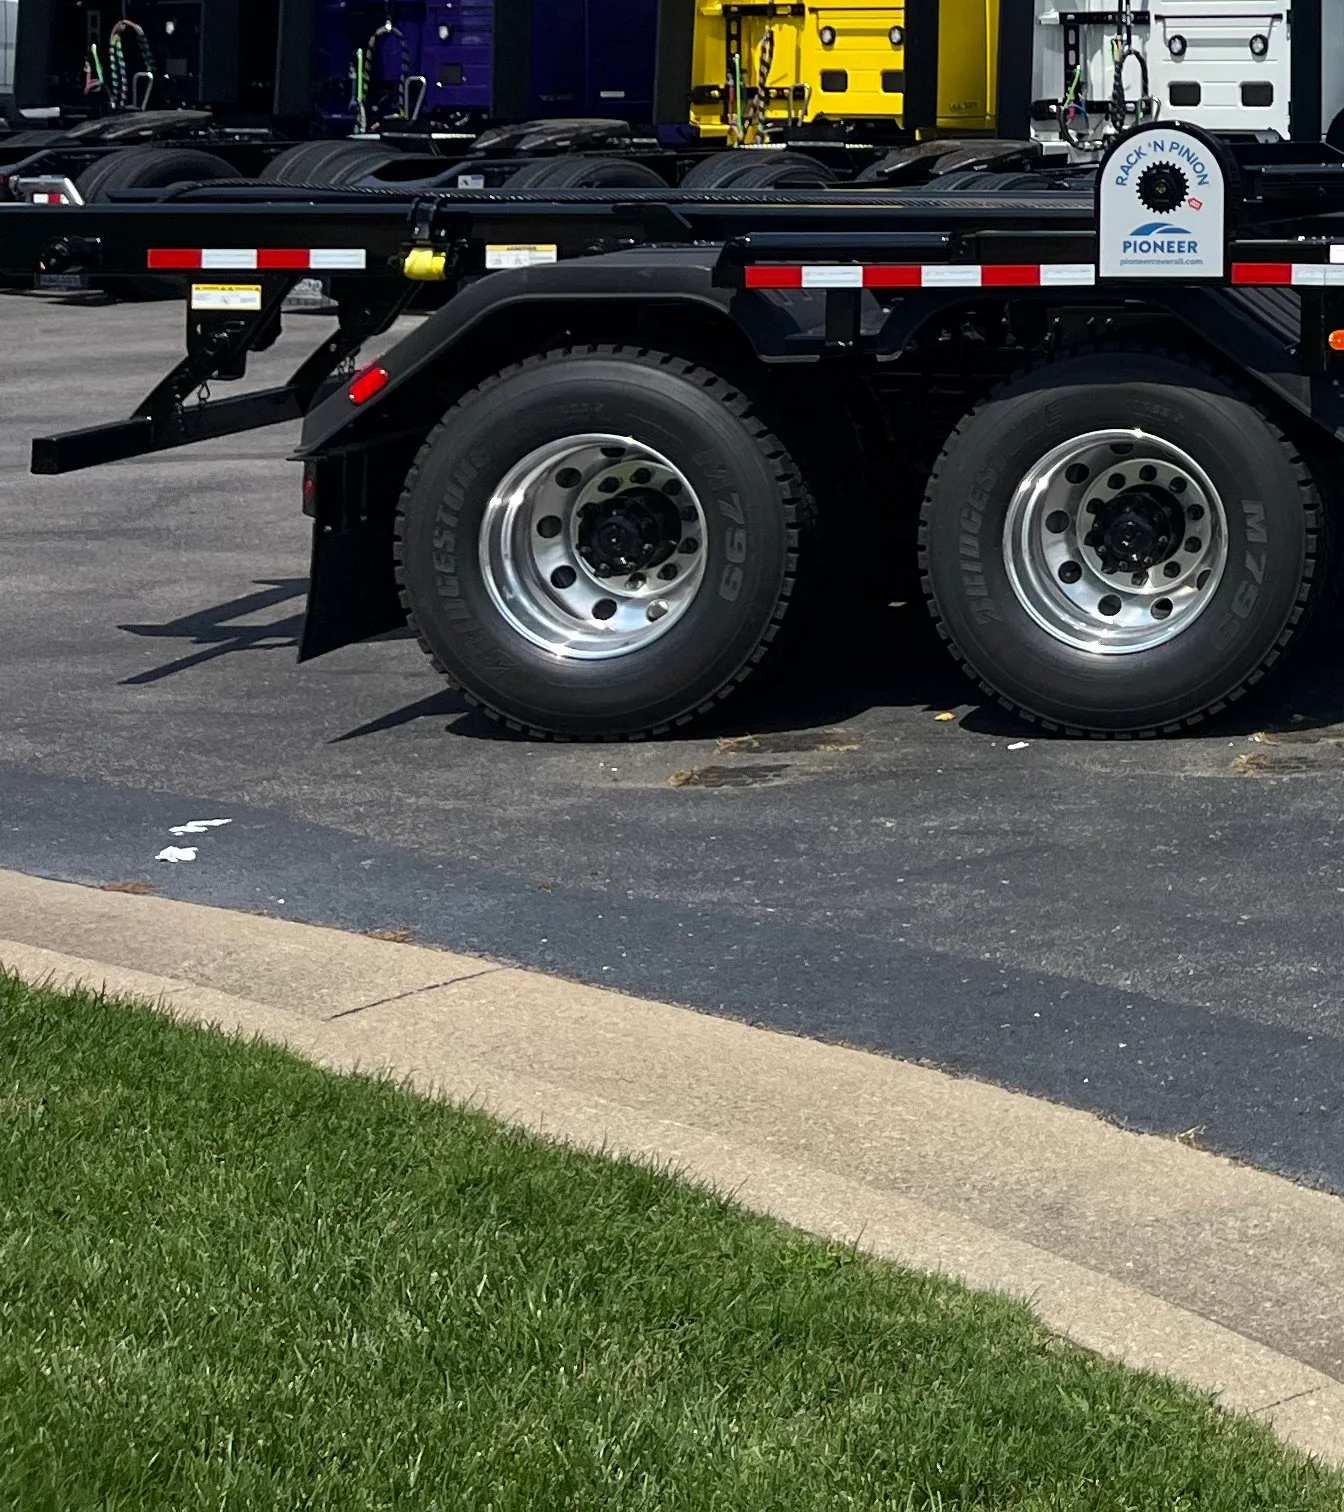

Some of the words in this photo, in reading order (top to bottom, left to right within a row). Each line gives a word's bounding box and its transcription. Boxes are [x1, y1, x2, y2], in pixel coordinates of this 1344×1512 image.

[1115, 145, 1147, 186] RACK
[1168, 141, 1210, 186] PINION
[1122, 240, 1199, 254] PIONEER
